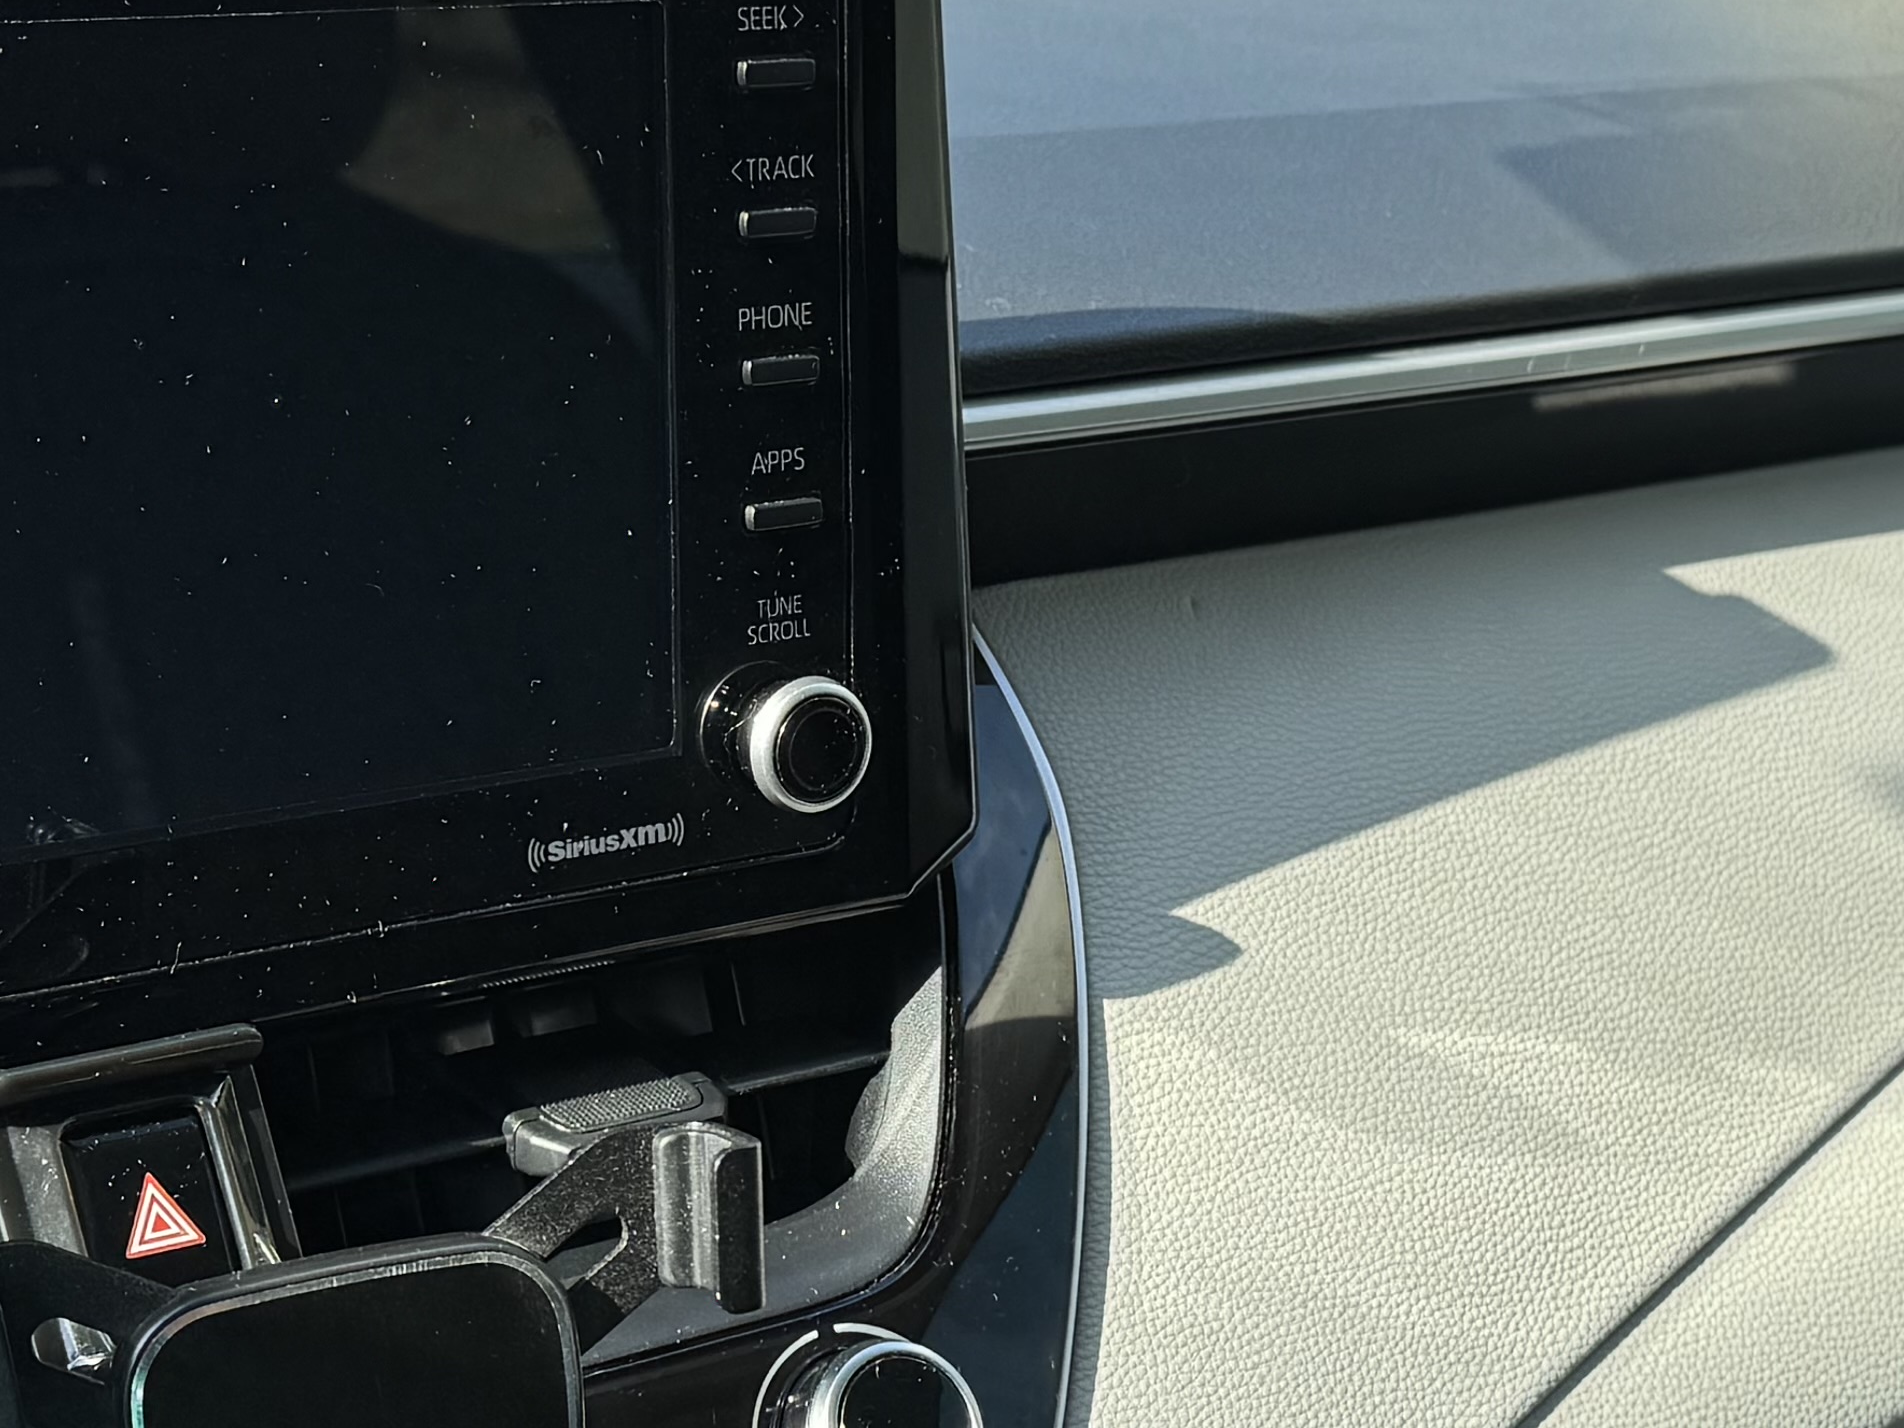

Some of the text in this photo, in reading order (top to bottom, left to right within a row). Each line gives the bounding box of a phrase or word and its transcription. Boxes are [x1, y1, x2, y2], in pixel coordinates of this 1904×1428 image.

[738, 303, 812, 330] PHONE
[752, 448, 805, 474] APPS
[757, 595, 803, 619] TUNE
[747, 617, 811, 646] SCROLL
